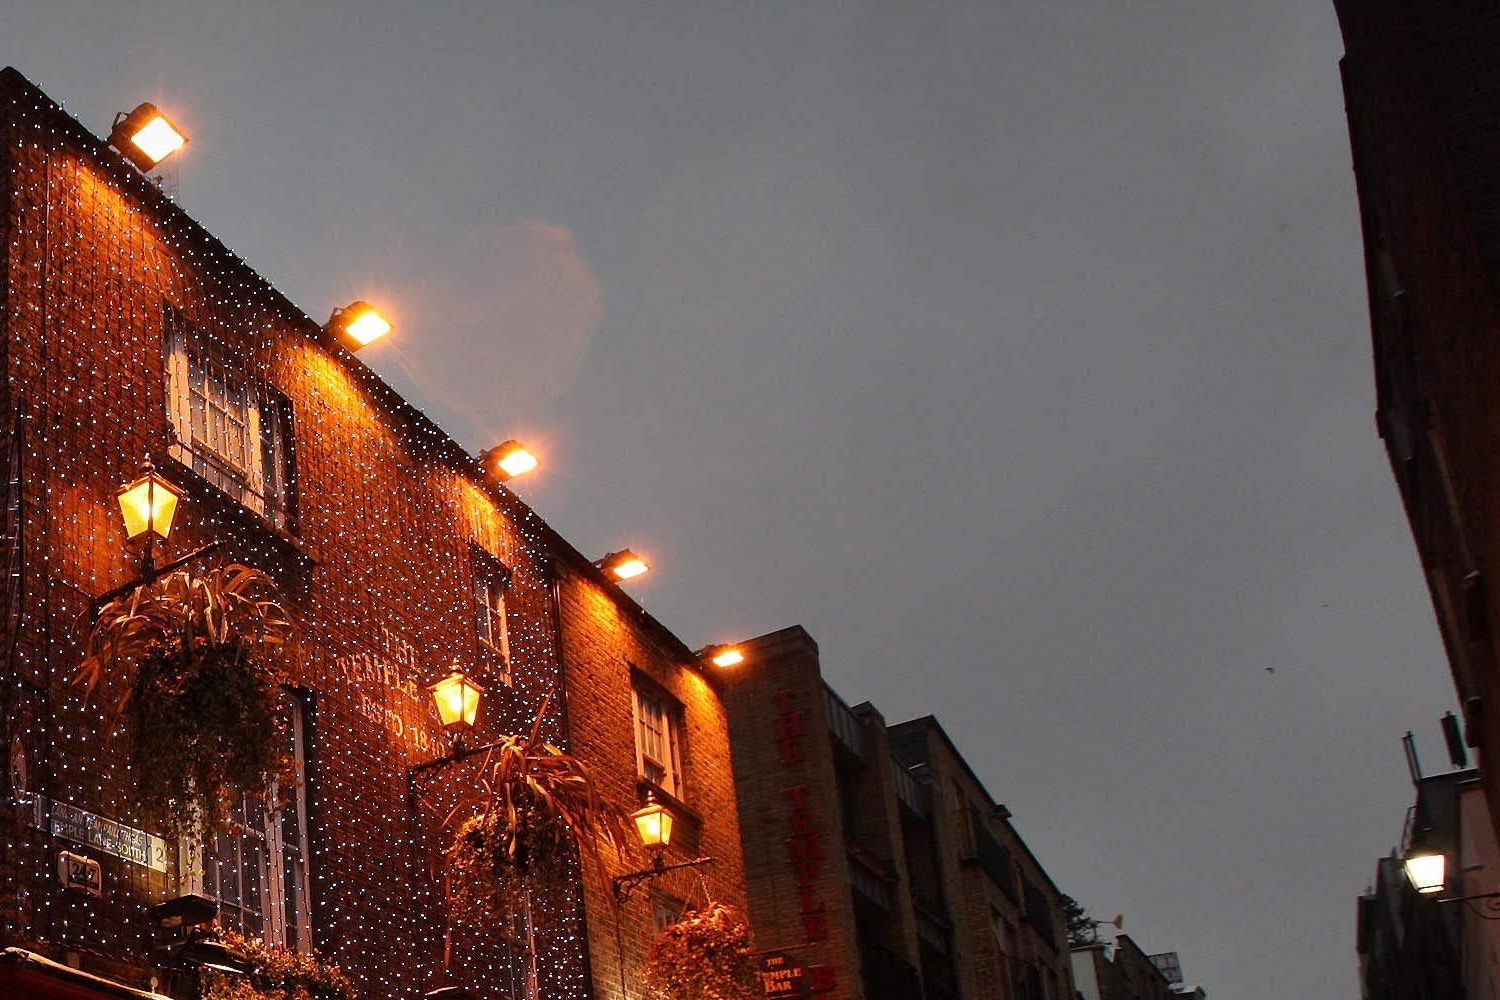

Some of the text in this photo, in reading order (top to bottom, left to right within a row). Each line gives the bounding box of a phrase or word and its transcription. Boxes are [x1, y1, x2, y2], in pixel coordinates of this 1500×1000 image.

[117, 841, 147, 861] SOUTH
[155, 847, 164, 864] 2
[764, 980, 793, 993] BAR
